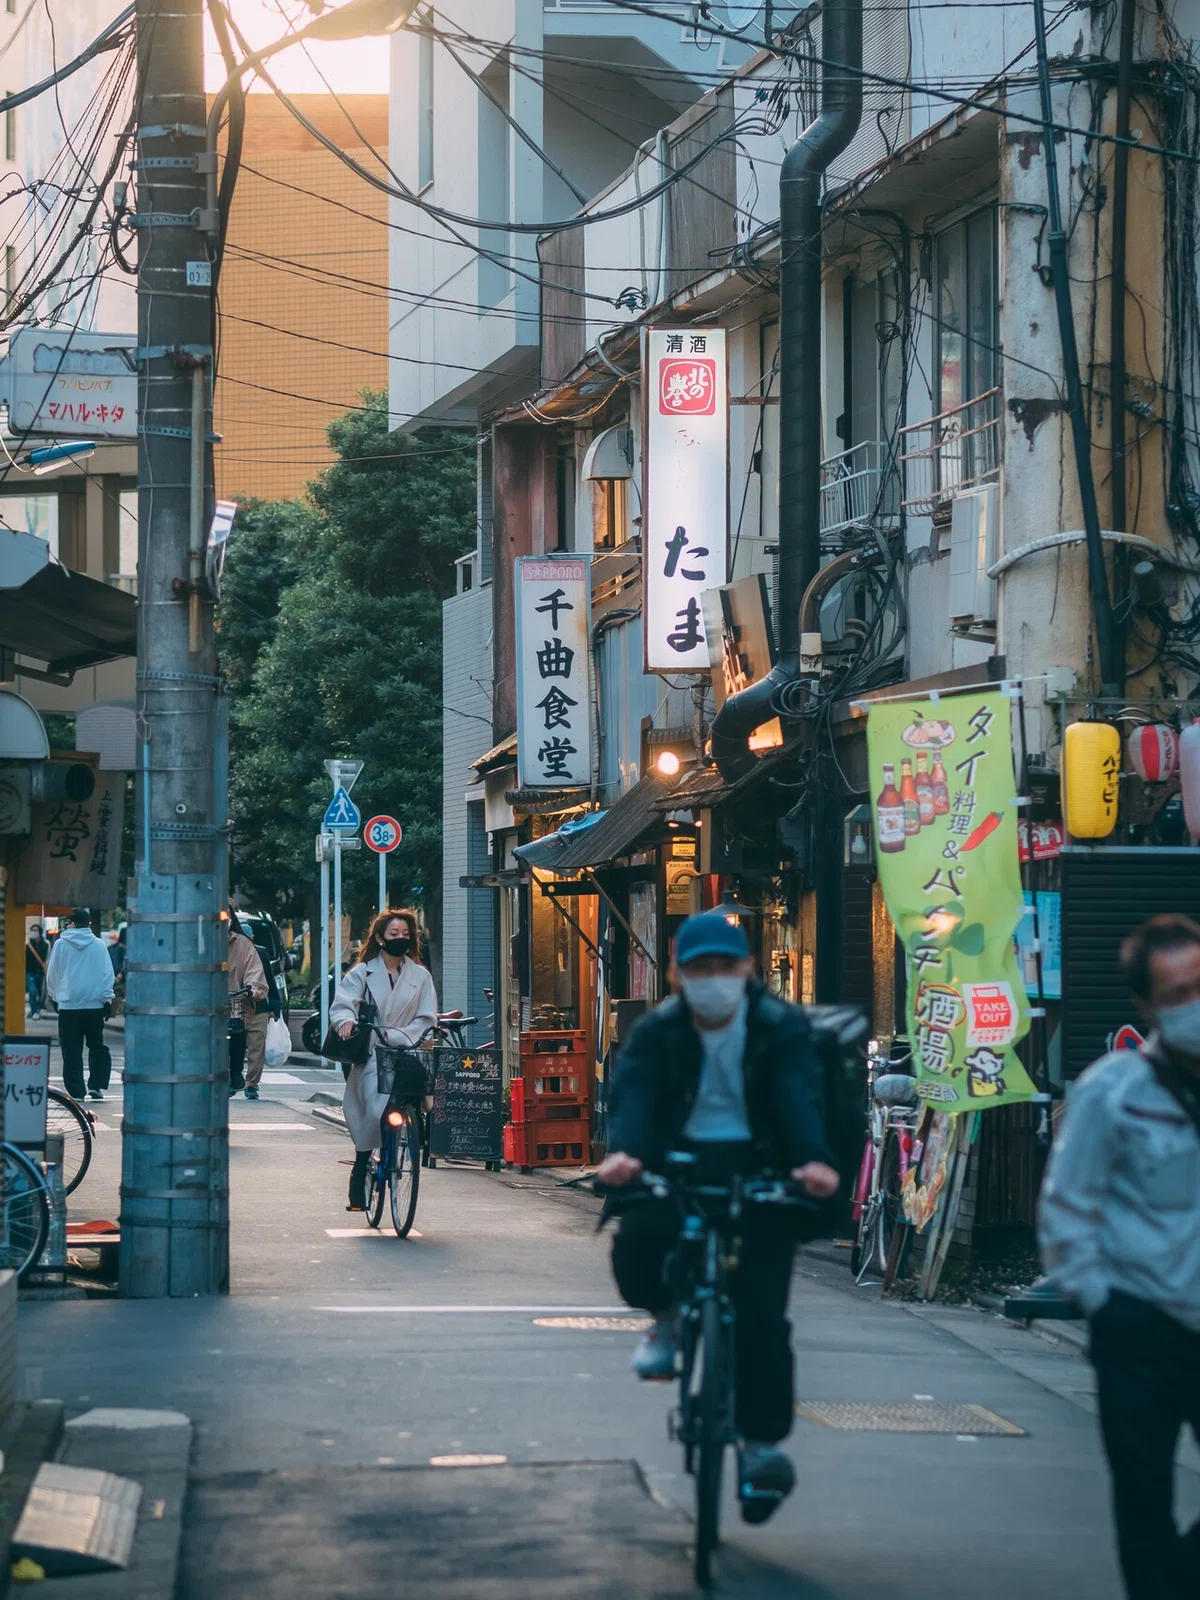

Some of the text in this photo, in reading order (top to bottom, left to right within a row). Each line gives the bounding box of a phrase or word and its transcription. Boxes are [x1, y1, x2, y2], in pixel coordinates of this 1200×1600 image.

[666, 334, 707, 354] 清酒
[535, 588, 578, 779] 千曲食堂
[974, 1002, 1009, 1012] TAKE
[980, 1013, 1007, 1023] OUT
